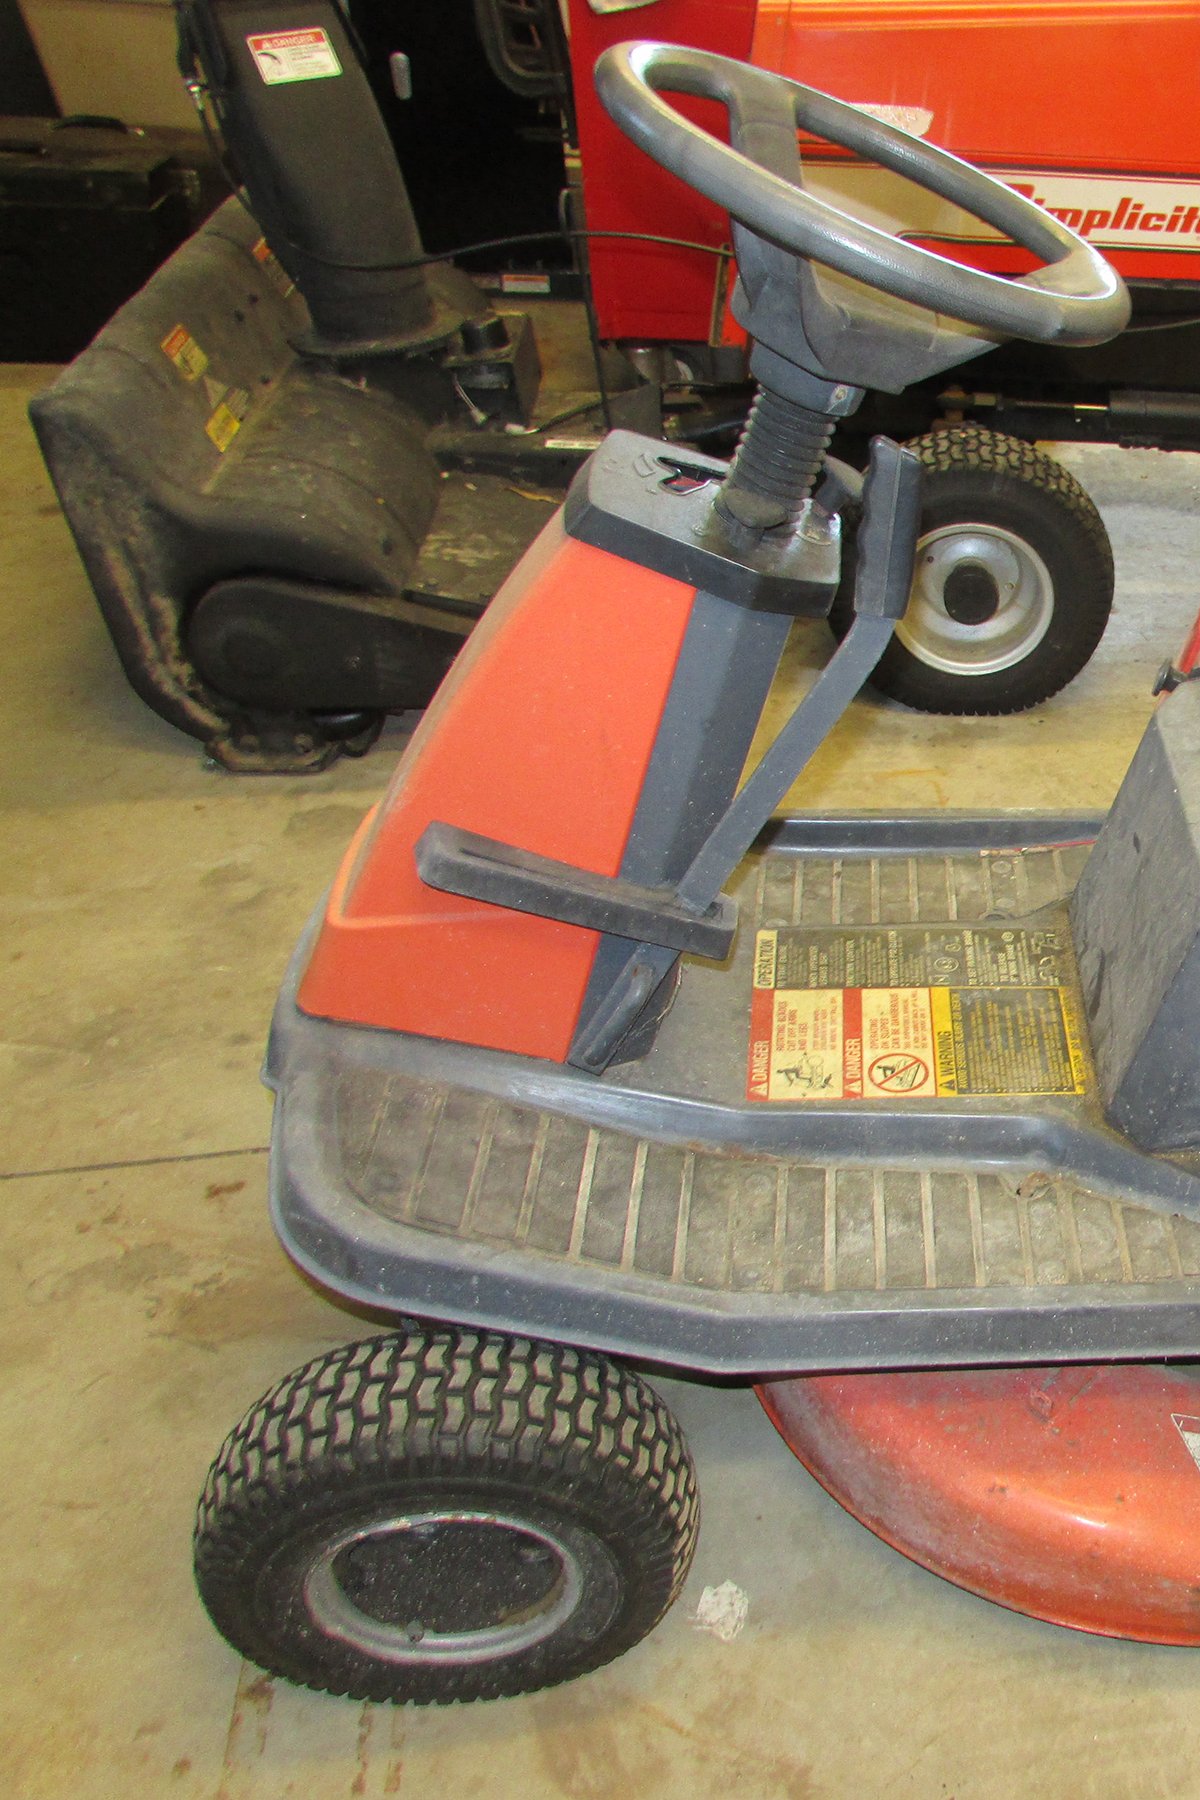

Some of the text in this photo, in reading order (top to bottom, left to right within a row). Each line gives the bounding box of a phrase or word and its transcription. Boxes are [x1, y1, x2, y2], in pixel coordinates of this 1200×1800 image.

[757, 940, 775, 986] OPERATION
[869, 1018, 879, 1049] OPERATING
[937, 1030, 955, 1077] WARNING
[752, 1040, 769, 1082] DANGER
[845, 1038, 861, 1079] DANGER
